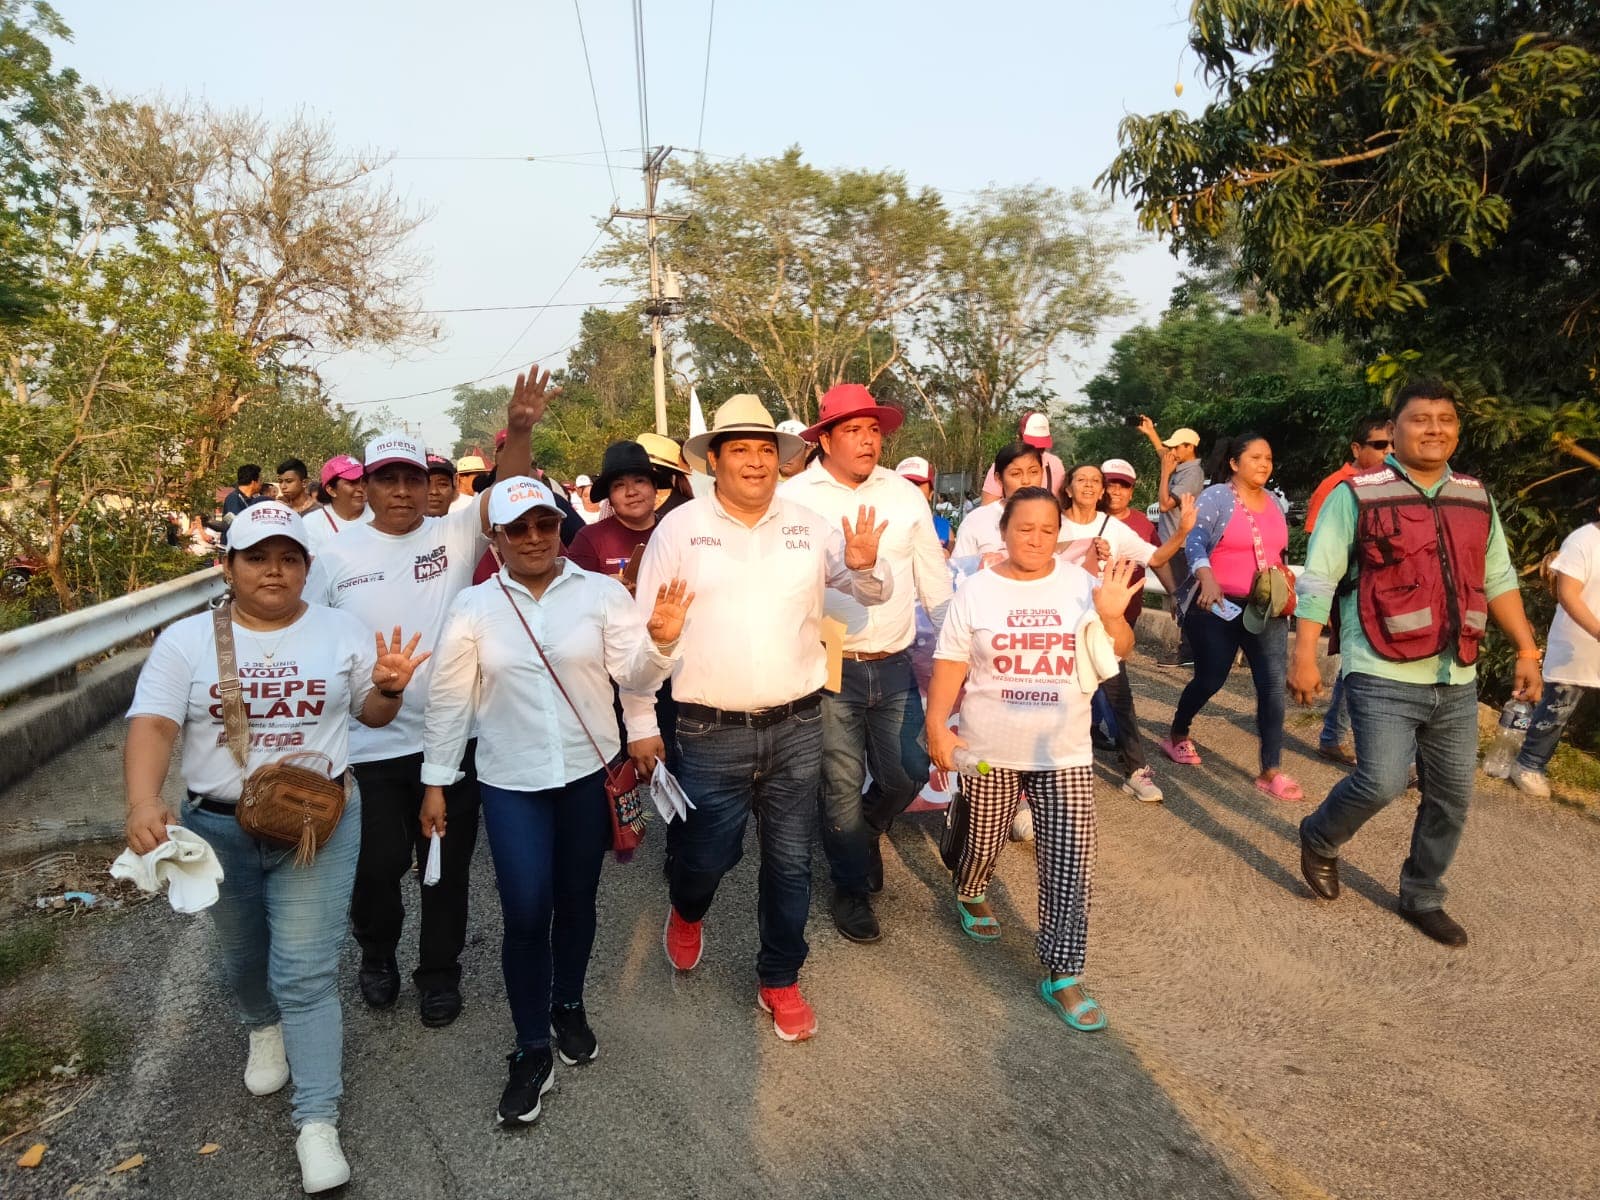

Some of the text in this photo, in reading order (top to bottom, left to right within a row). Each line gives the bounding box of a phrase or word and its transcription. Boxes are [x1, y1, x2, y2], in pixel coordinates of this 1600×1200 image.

[376, 440, 417, 452] morena
[781, 525, 810, 536] CHEPE
[690, 536, 722, 546] MORENA
[415, 556, 448, 579] MAY
[337, 577, 368, 591] morena
[1009, 615, 1059, 627] VOTA
[991, 633, 1076, 651] CHEPE
[992, 650, 1075, 676] OLÁN
[241, 667, 297, 677] VOTA
[209, 680, 326, 699] CHEPE
[1001, 689, 1059, 702] morena
[217, 732, 303, 747] mrena
